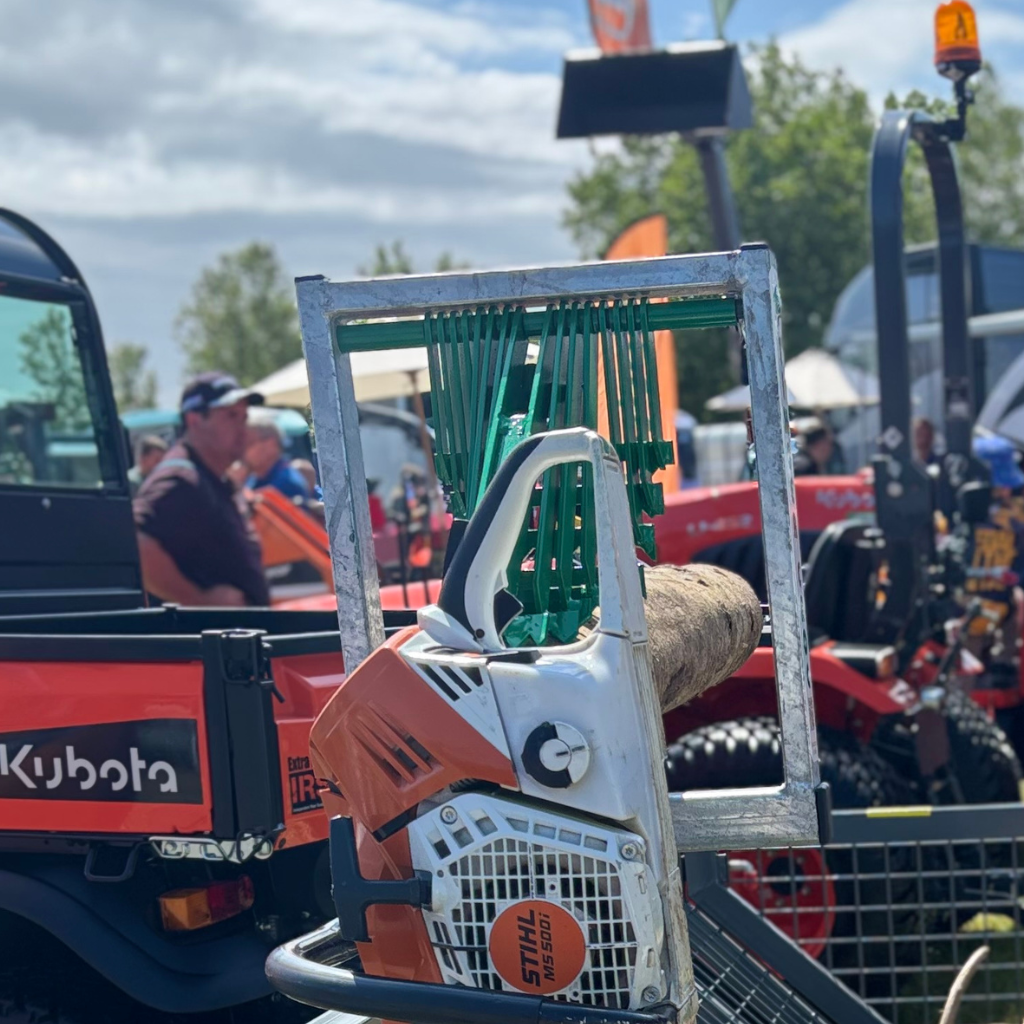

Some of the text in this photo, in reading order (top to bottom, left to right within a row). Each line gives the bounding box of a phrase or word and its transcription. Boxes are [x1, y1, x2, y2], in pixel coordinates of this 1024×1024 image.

[0, 744, 178, 792] Kubota
[287, 756, 310, 771] Extra
[516, 909, 541, 987] STIHL
[539, 912, 555, 953] 500i
